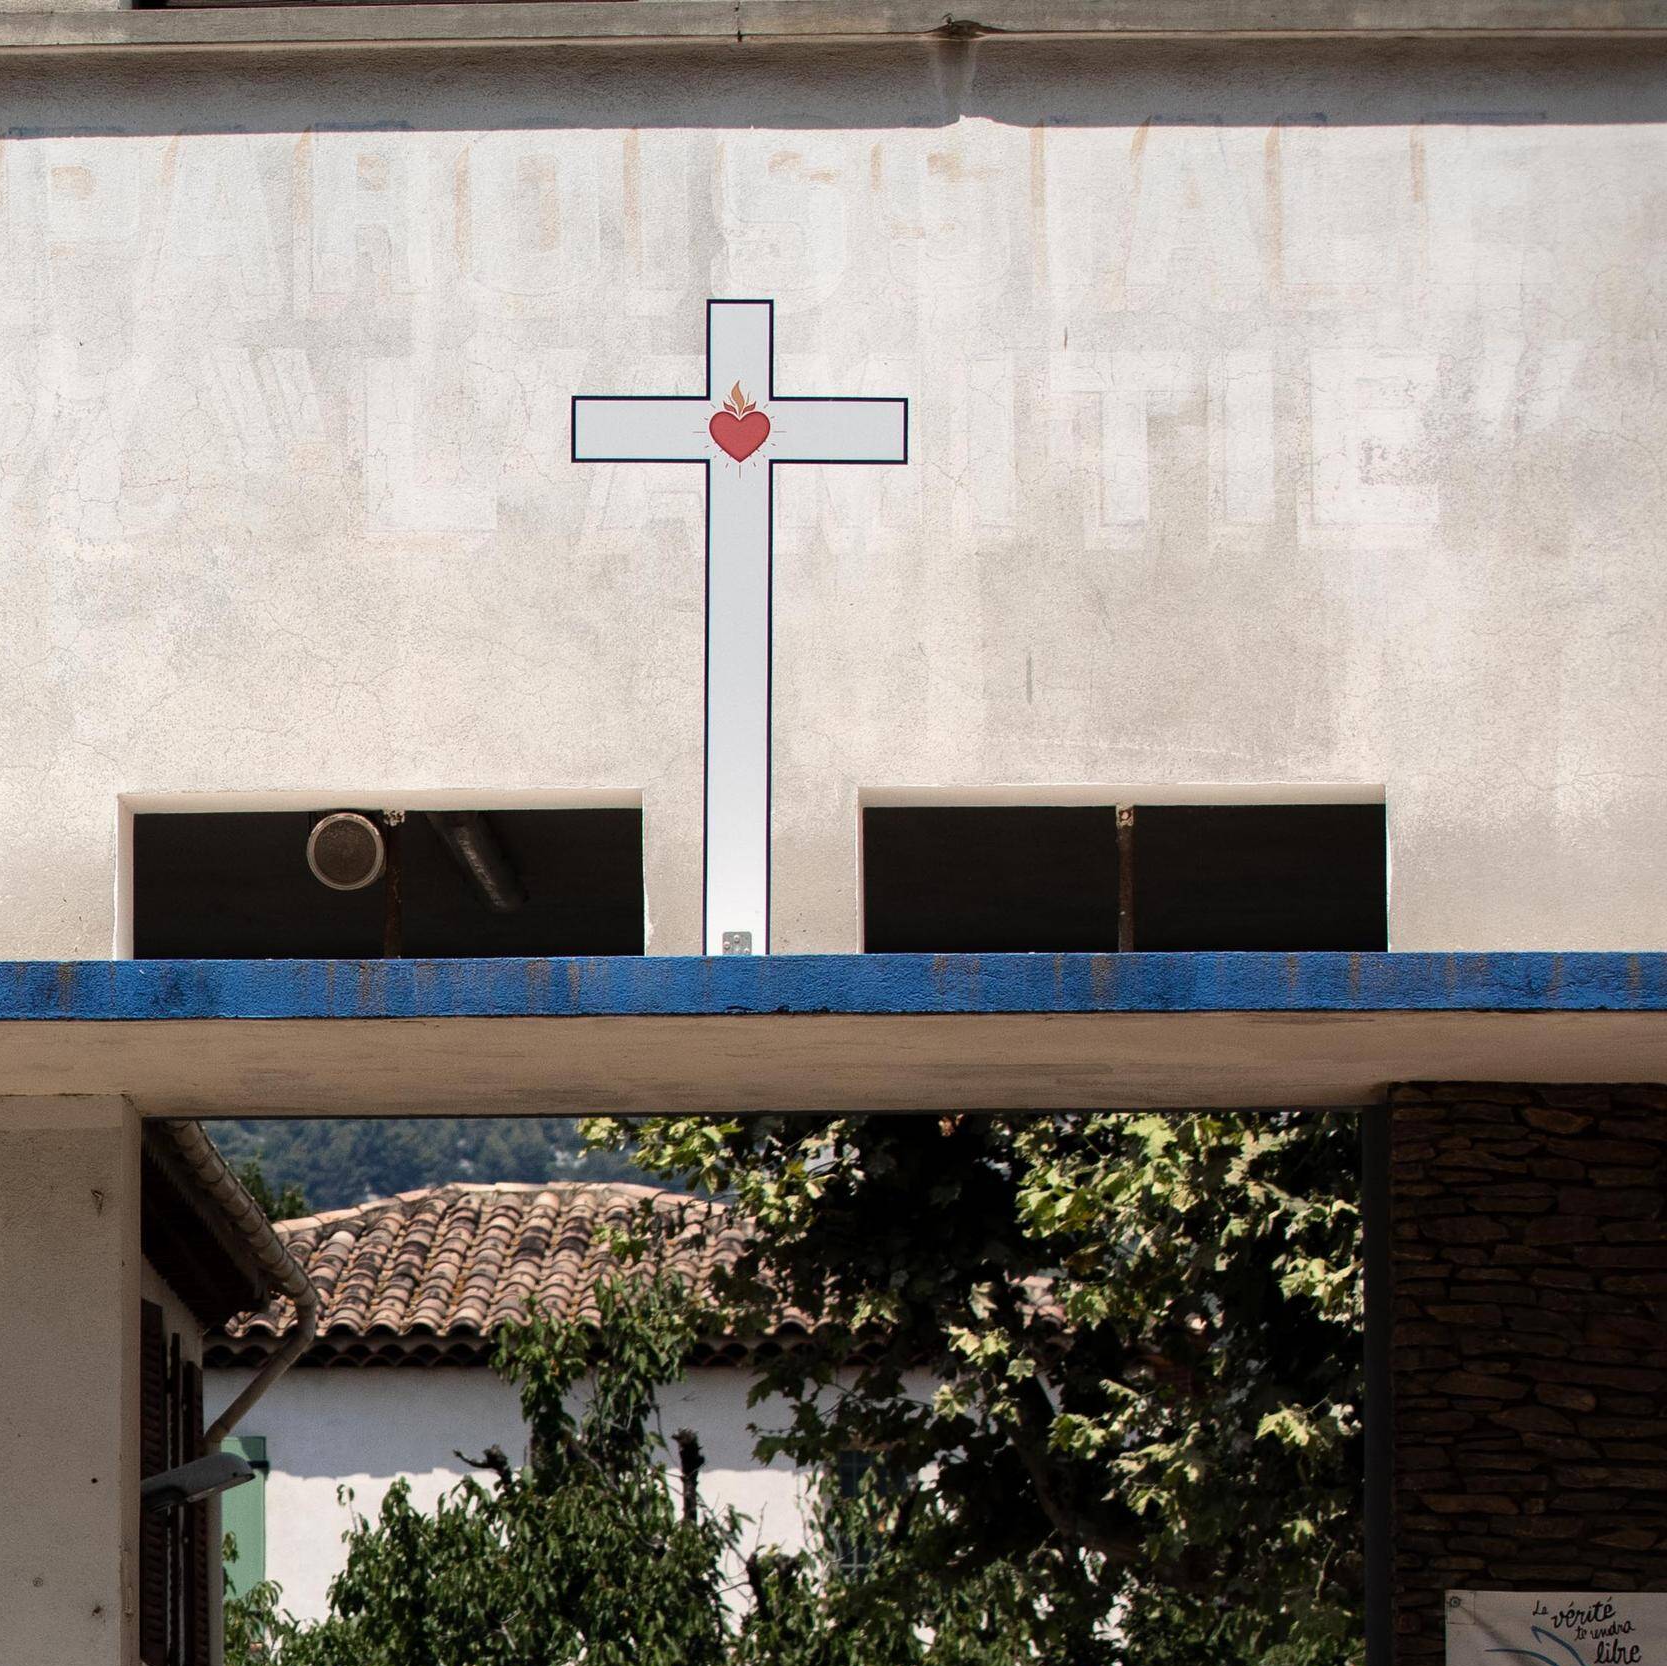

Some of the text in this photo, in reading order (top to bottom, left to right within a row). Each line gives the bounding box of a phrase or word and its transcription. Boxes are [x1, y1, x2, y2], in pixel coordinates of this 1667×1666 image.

[1531, 1596, 1616, 1628] La vérité
[1594, 1639, 1642, 1665] libre
